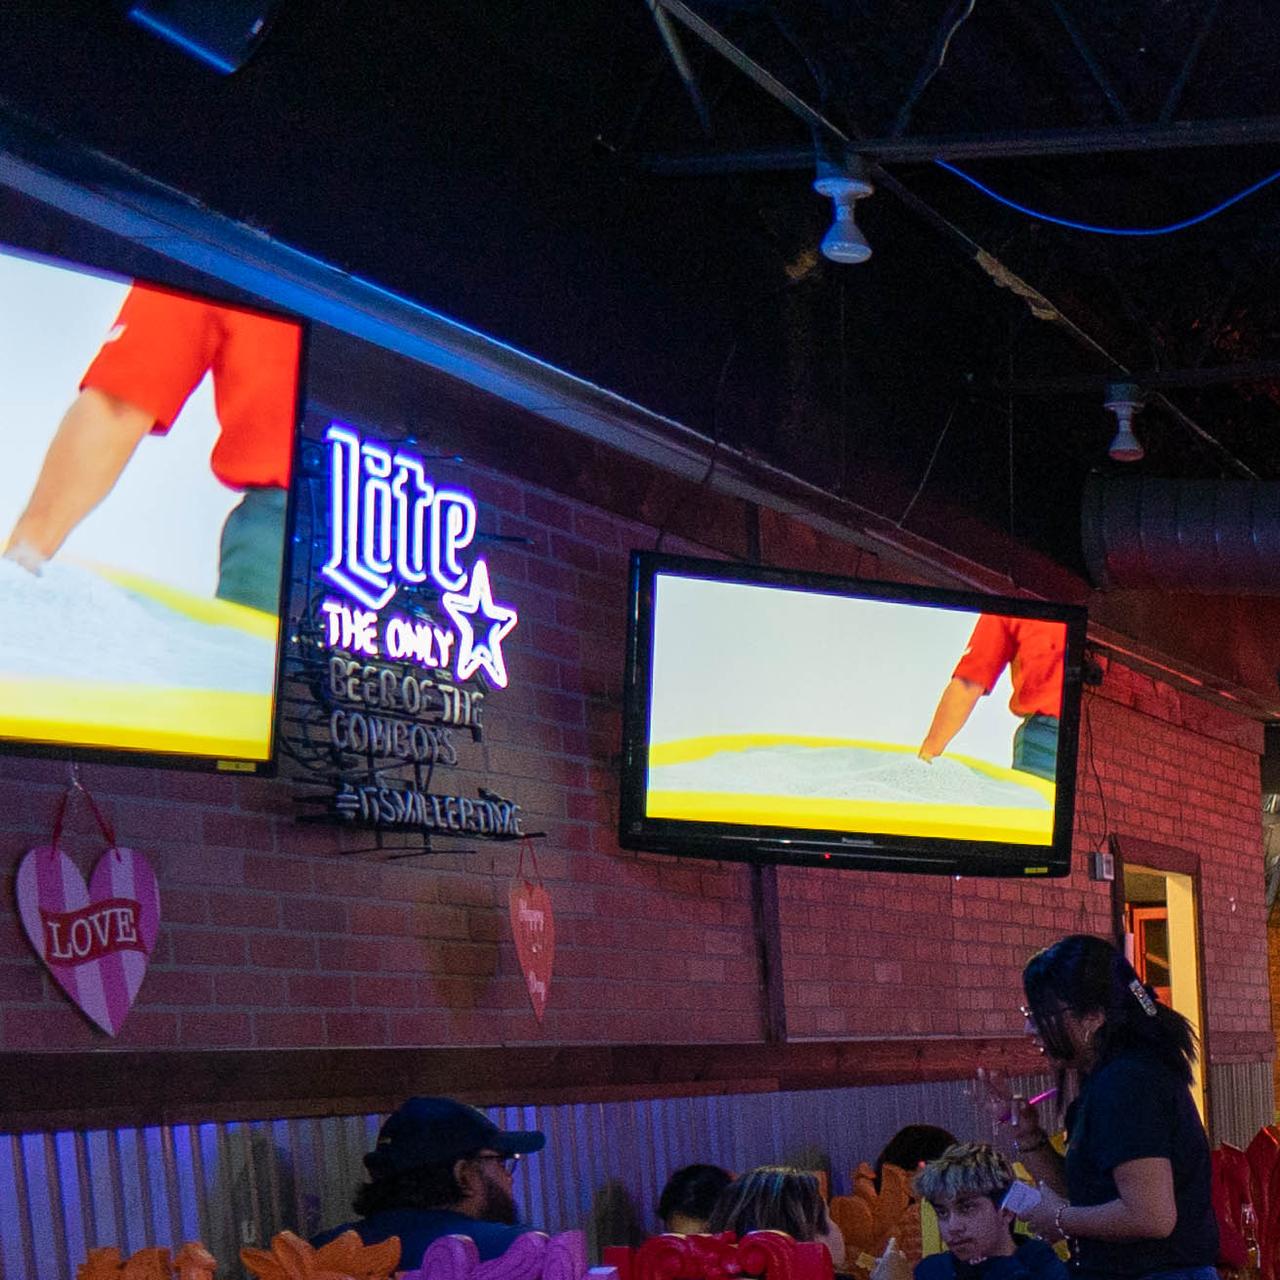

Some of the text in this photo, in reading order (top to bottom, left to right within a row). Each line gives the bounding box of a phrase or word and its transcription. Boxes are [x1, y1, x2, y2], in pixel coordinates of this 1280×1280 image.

[322, 423, 478, 610] Lite
[322, 601, 455, 669] THE ONLY
[329, 656, 485, 729] BEER OF THE
[330, 709, 459, 766] COWBOYS
[47, 907, 138, 958] LOVE
